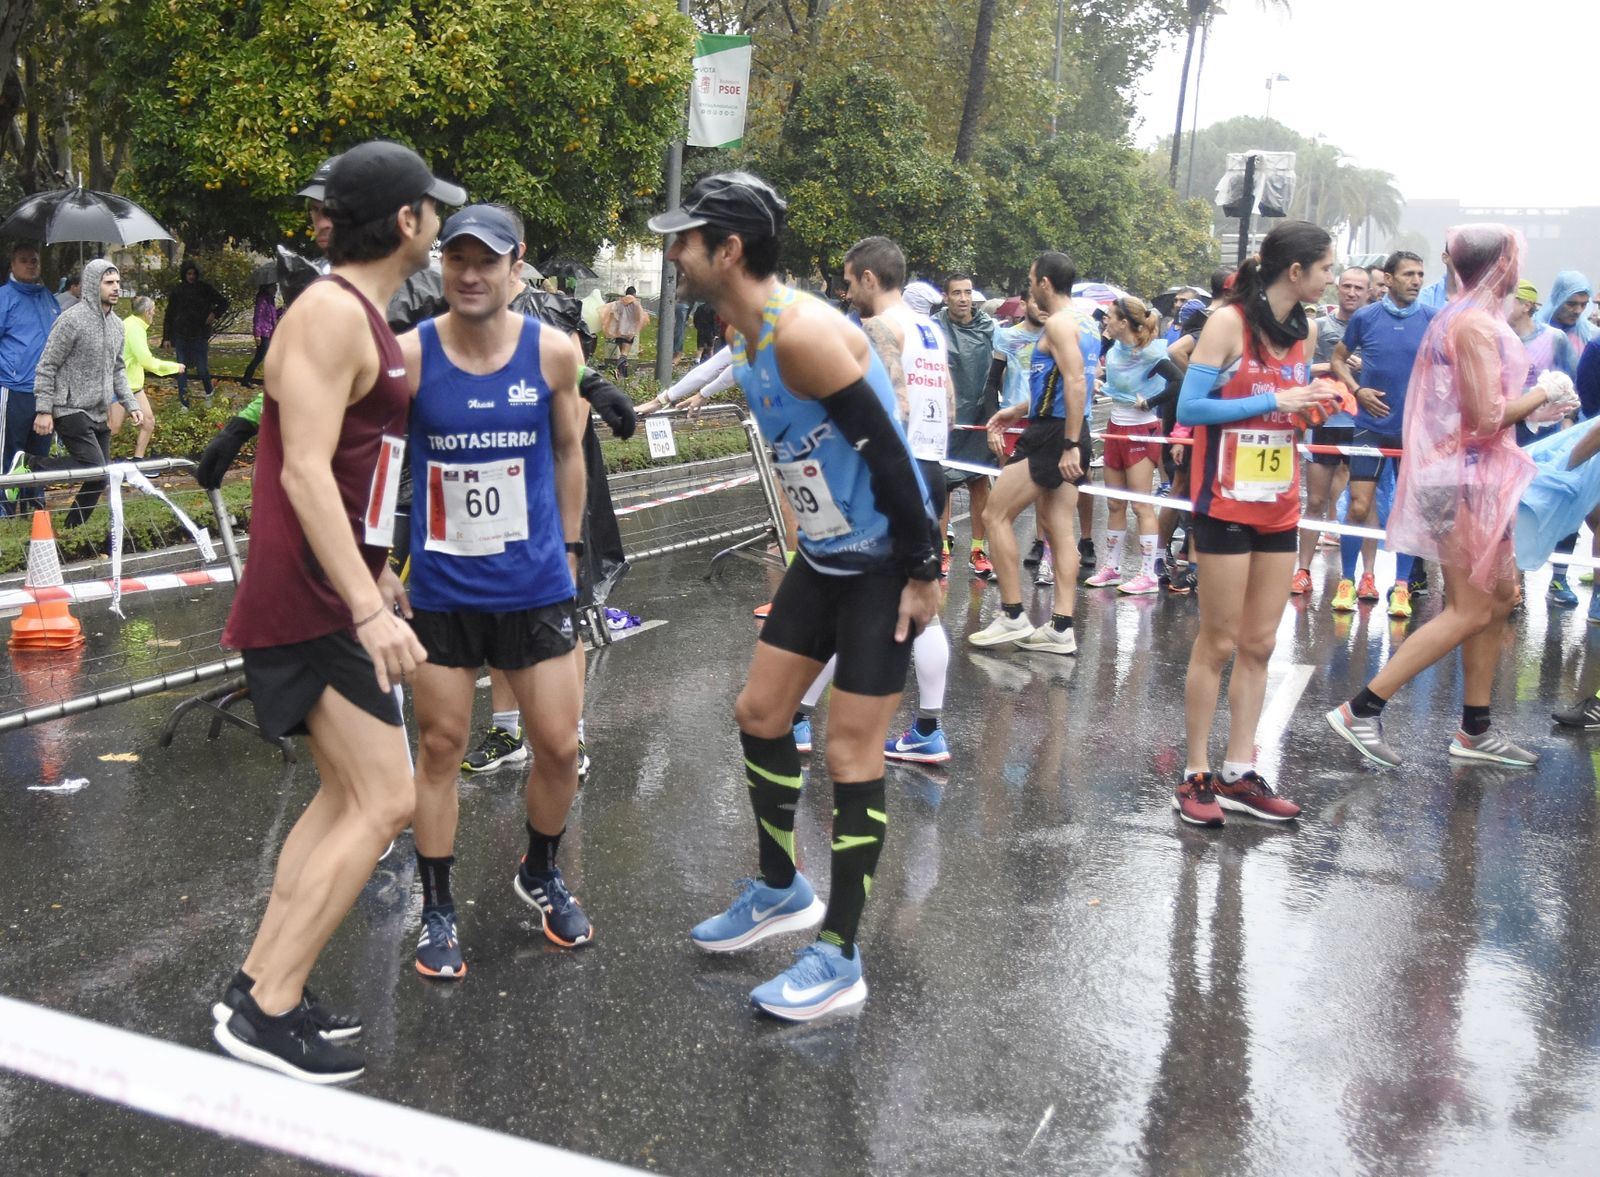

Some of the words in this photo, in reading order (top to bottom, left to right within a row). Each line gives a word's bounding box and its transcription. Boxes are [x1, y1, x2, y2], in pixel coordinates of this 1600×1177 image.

[719, 85, 741, 95] PSOE
[427, 431, 538, 451] TROTASIERRA
[773, 422, 836, 460] SUR
[1256, 449, 1281, 473] 15
[465, 486, 500, 519] 60
